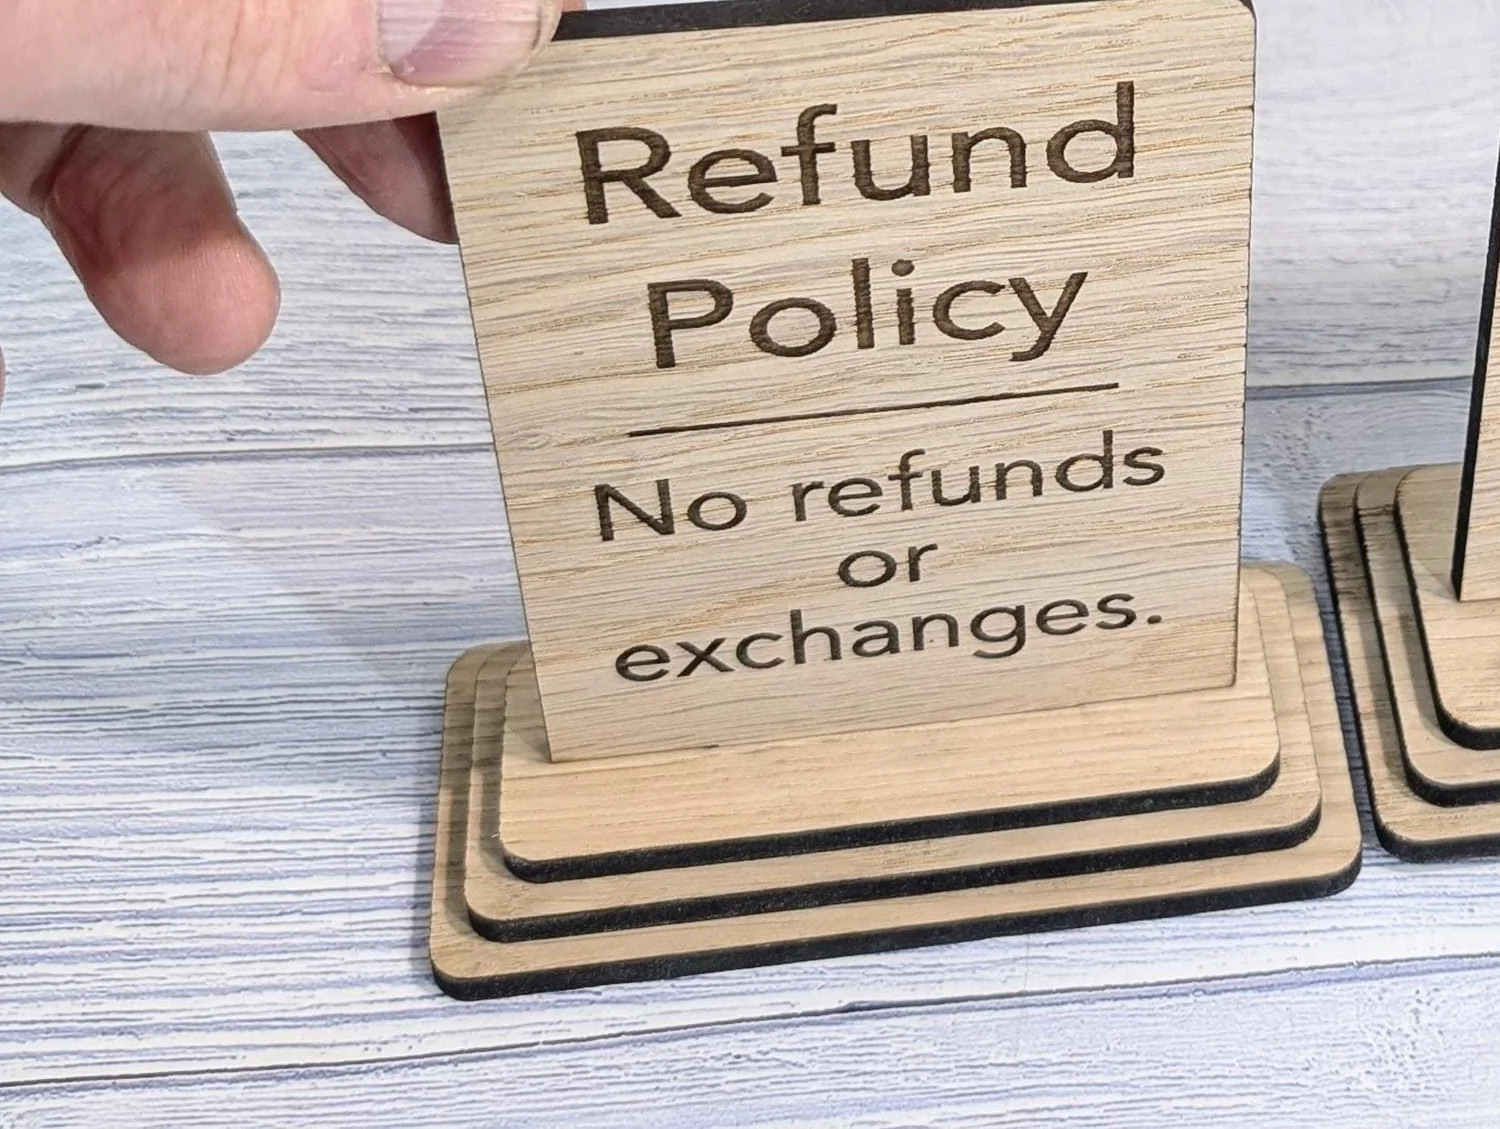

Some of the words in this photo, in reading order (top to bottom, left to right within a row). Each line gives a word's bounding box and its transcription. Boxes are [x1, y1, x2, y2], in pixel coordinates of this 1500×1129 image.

[573, 81, 1137, 225] Refund
[647, 258, 1088, 369] Policy
[592, 479, 749, 542] No
[788, 430, 1165, 522] refunds
[836, 544, 937, 588] or
[615, 594, 1164, 682] exchanges.
